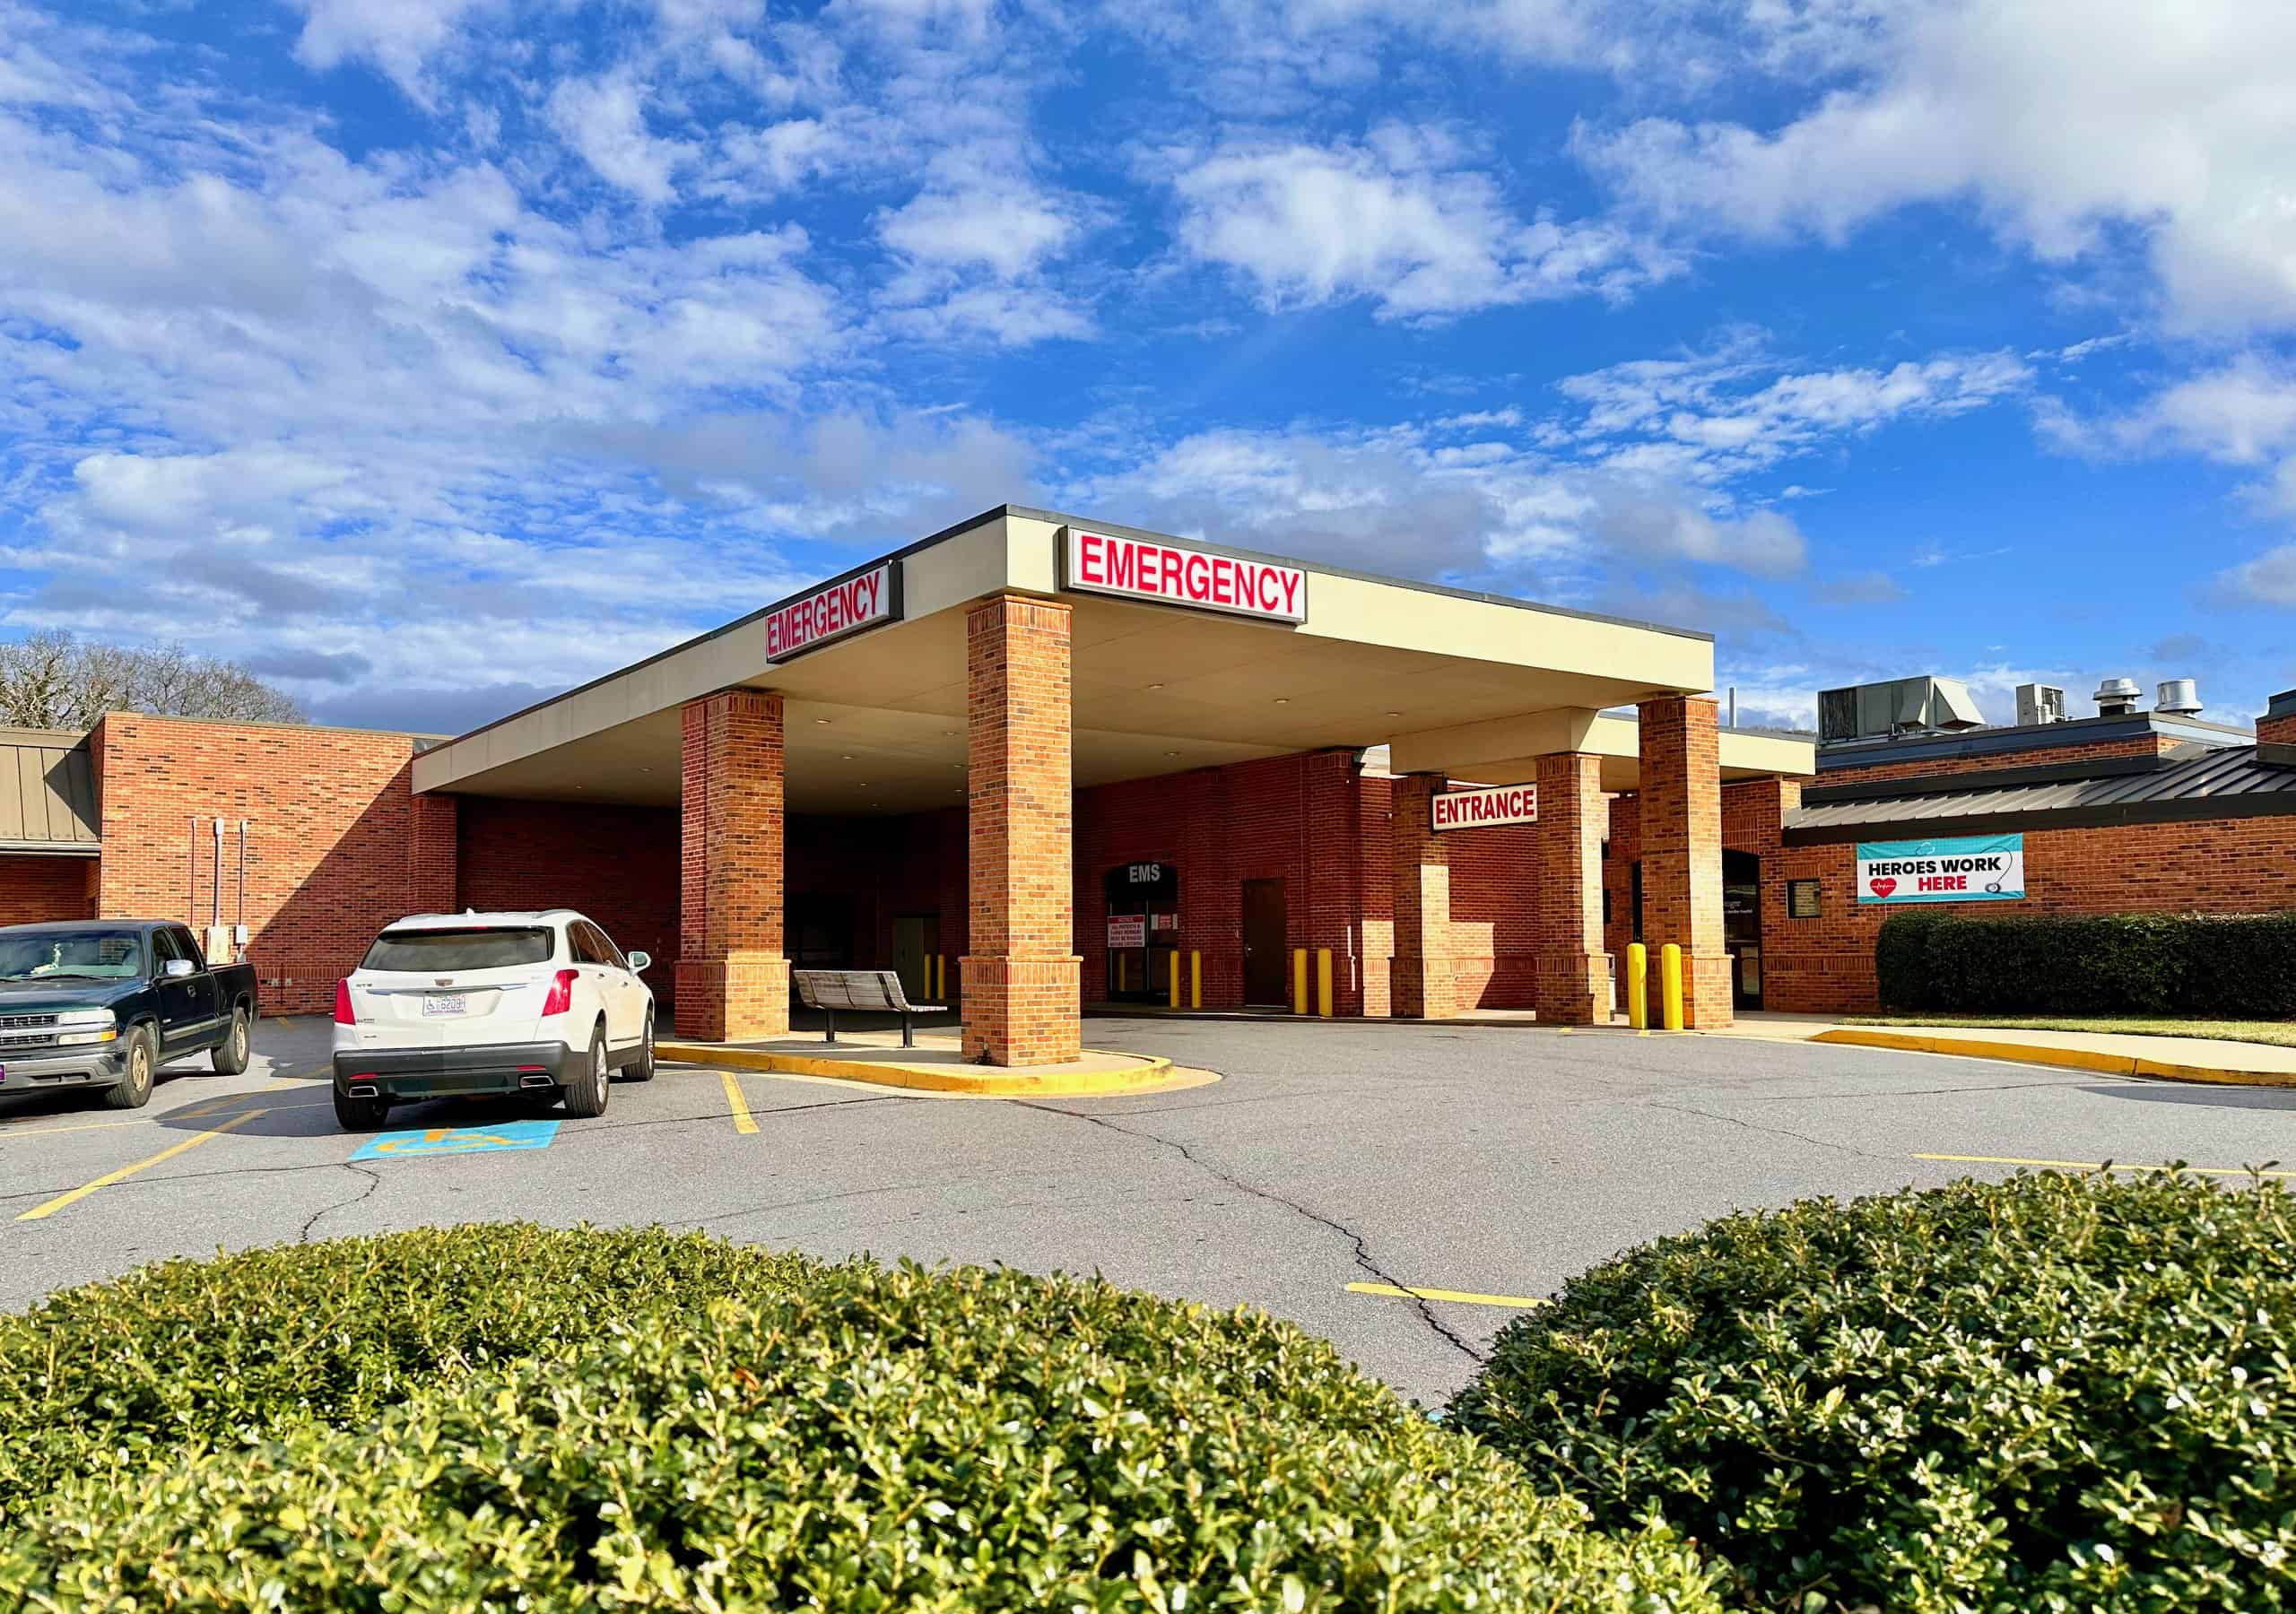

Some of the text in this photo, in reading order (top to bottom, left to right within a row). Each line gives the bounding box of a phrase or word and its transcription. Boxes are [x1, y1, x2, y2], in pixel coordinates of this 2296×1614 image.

[1081, 534, 1300, 613] EMERGENCY
[767, 570, 881, 655] EMERGENCY
[1435, 789, 1535, 824] ENTRANCE
[1129, 863, 1161, 883] EMS
[1868, 856, 2002, 876] HEROES WORK
[1918, 875, 1968, 891] HERE
